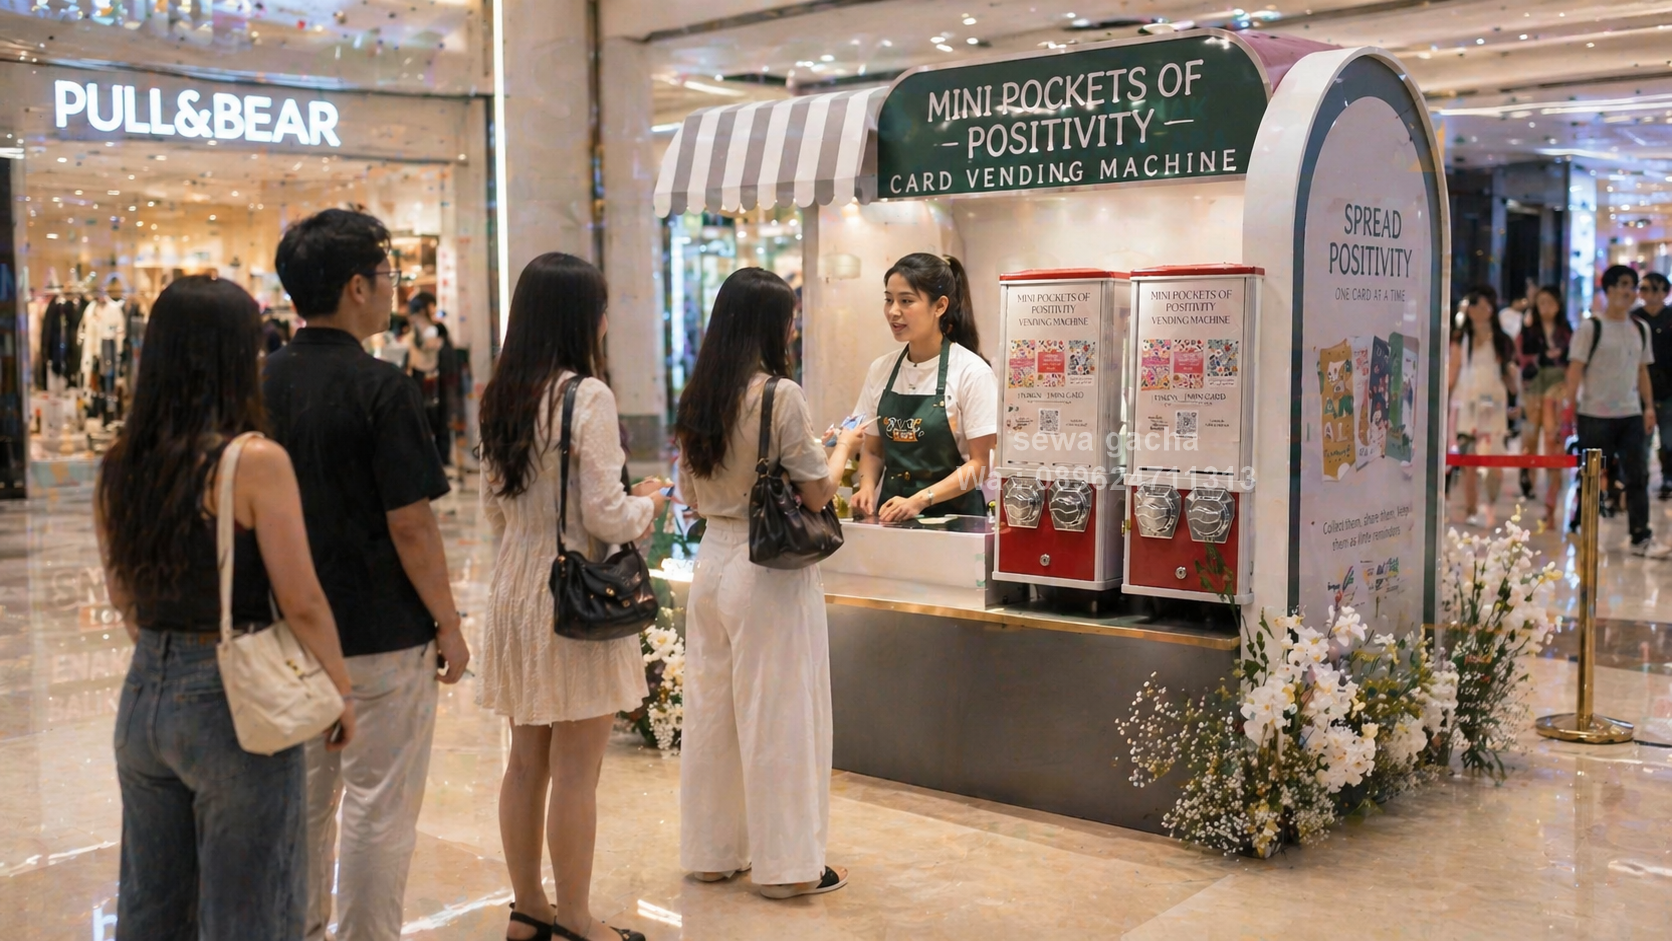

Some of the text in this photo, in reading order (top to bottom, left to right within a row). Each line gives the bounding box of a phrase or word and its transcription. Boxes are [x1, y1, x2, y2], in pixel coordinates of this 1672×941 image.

[926, 59, 1205, 123] MINI POCKETS OF
[54, 79, 342, 148] PULL&BEAR
[967, 108, 1155, 159] POSITIVITY
[890, 149, 1237, 194] CARD VENDING MACHINE
[1344, 203, 1402, 239] SPREAD
[1329, 241, 1413, 278] POSITIVITY
[1017, 292, 1091, 303] MINI POCKETS OF
[1150, 289, 1233, 301] MINI POCKETS OF
[1166, 301, 1217, 312] POSITIVITY
[1335, 286, 1350, 301] ONE
[1352, 287, 1372, 301] CARD
[1390, 289, 1406, 302] TIME
[1151, 315, 1231, 325] VENDING MACHINE
